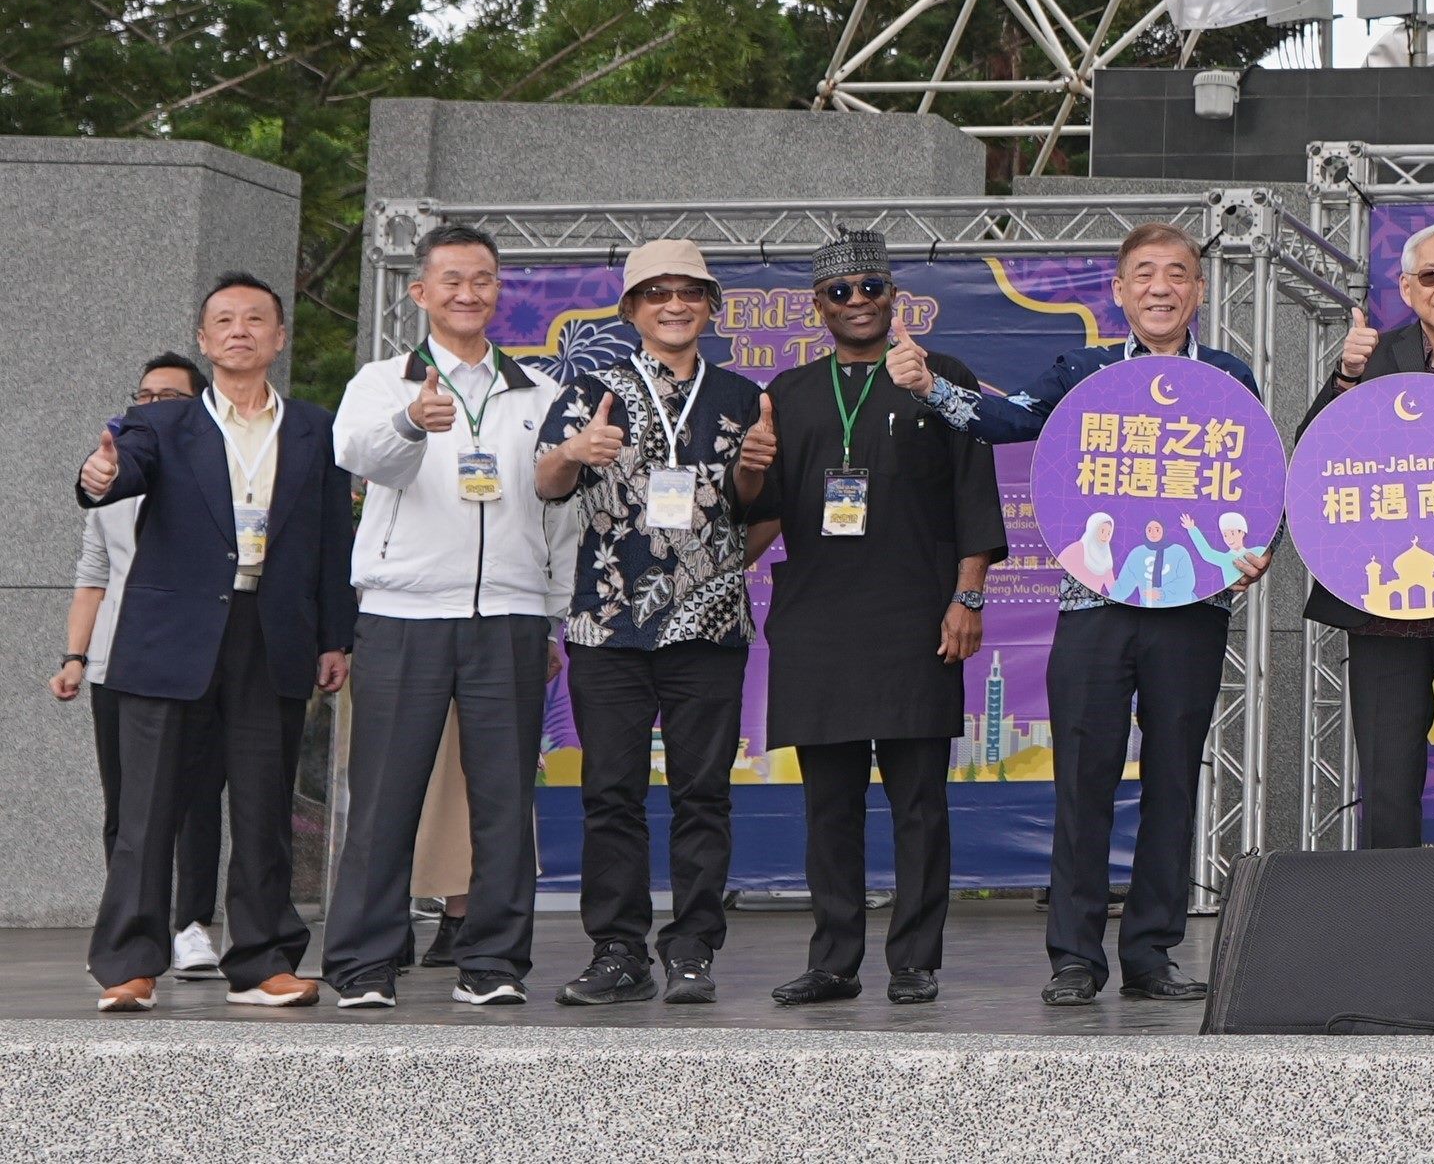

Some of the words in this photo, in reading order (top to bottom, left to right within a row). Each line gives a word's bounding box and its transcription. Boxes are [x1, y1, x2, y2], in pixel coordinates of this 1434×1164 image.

[739, 337, 775, 368] in
[1080, 412, 1246, 459] 開齋之約
[1075, 454, 1243, 502] 相遇臺北
